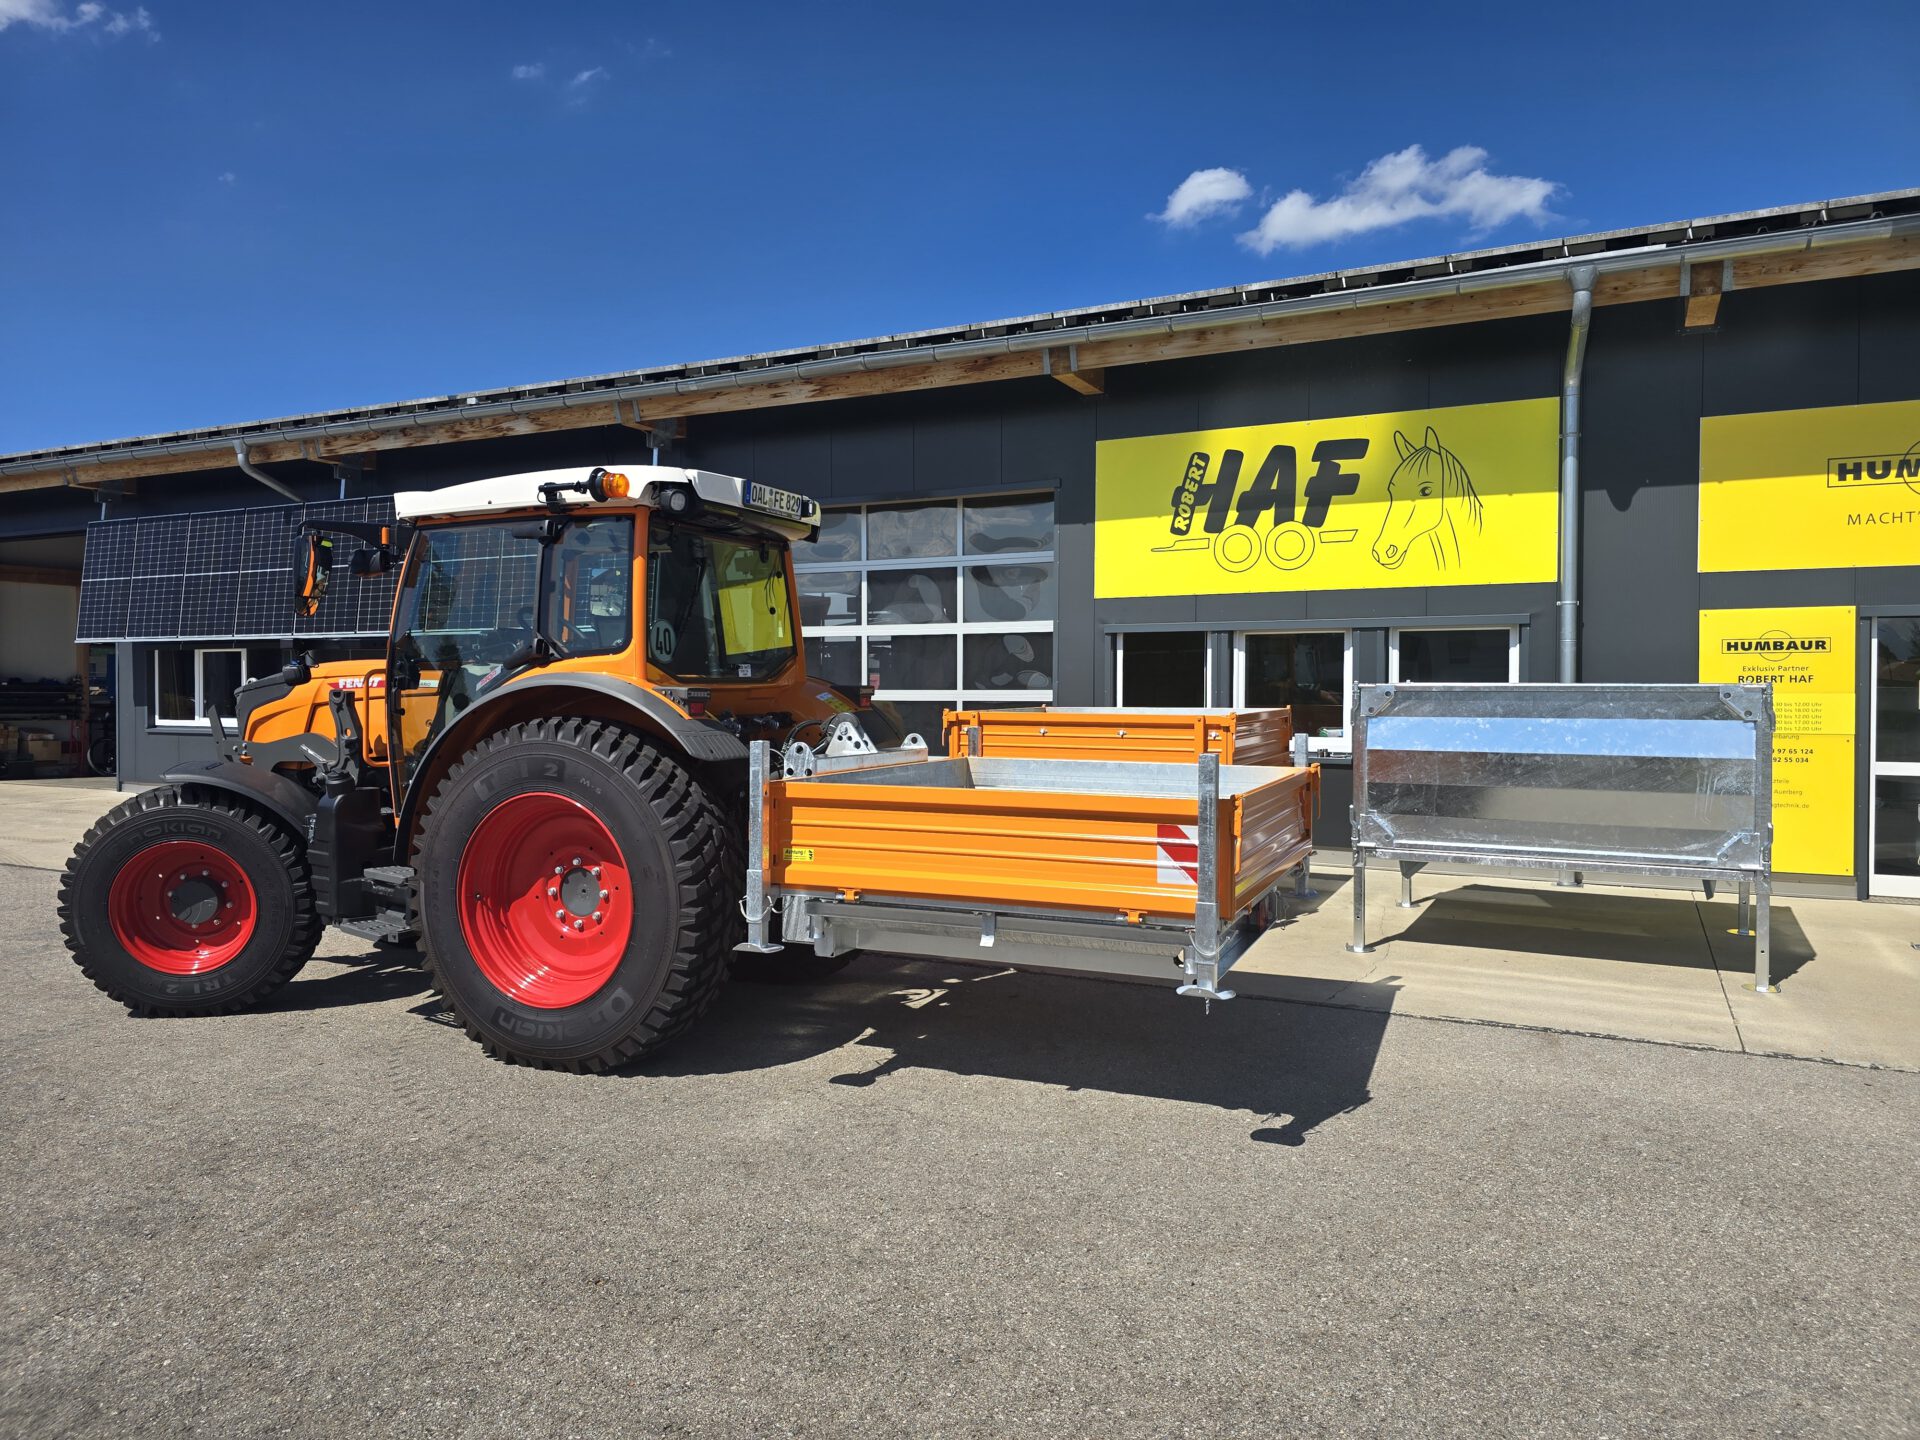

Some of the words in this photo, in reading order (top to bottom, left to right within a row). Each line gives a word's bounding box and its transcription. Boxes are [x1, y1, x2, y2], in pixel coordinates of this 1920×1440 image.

[752, 485, 768, 506] OAL
[774, 491, 785, 510] FE
[786, 494, 800, 513] 829
[1170, 438, 1370, 536] HAF
[1173, 455, 1206, 532] ROBERT
[655, 627, 672, 655] 40
[1726, 640, 1827, 652] HUMBAUR
[1738, 674, 1785, 684] ROBERT
[1789, 674, 1814, 683] HAF
